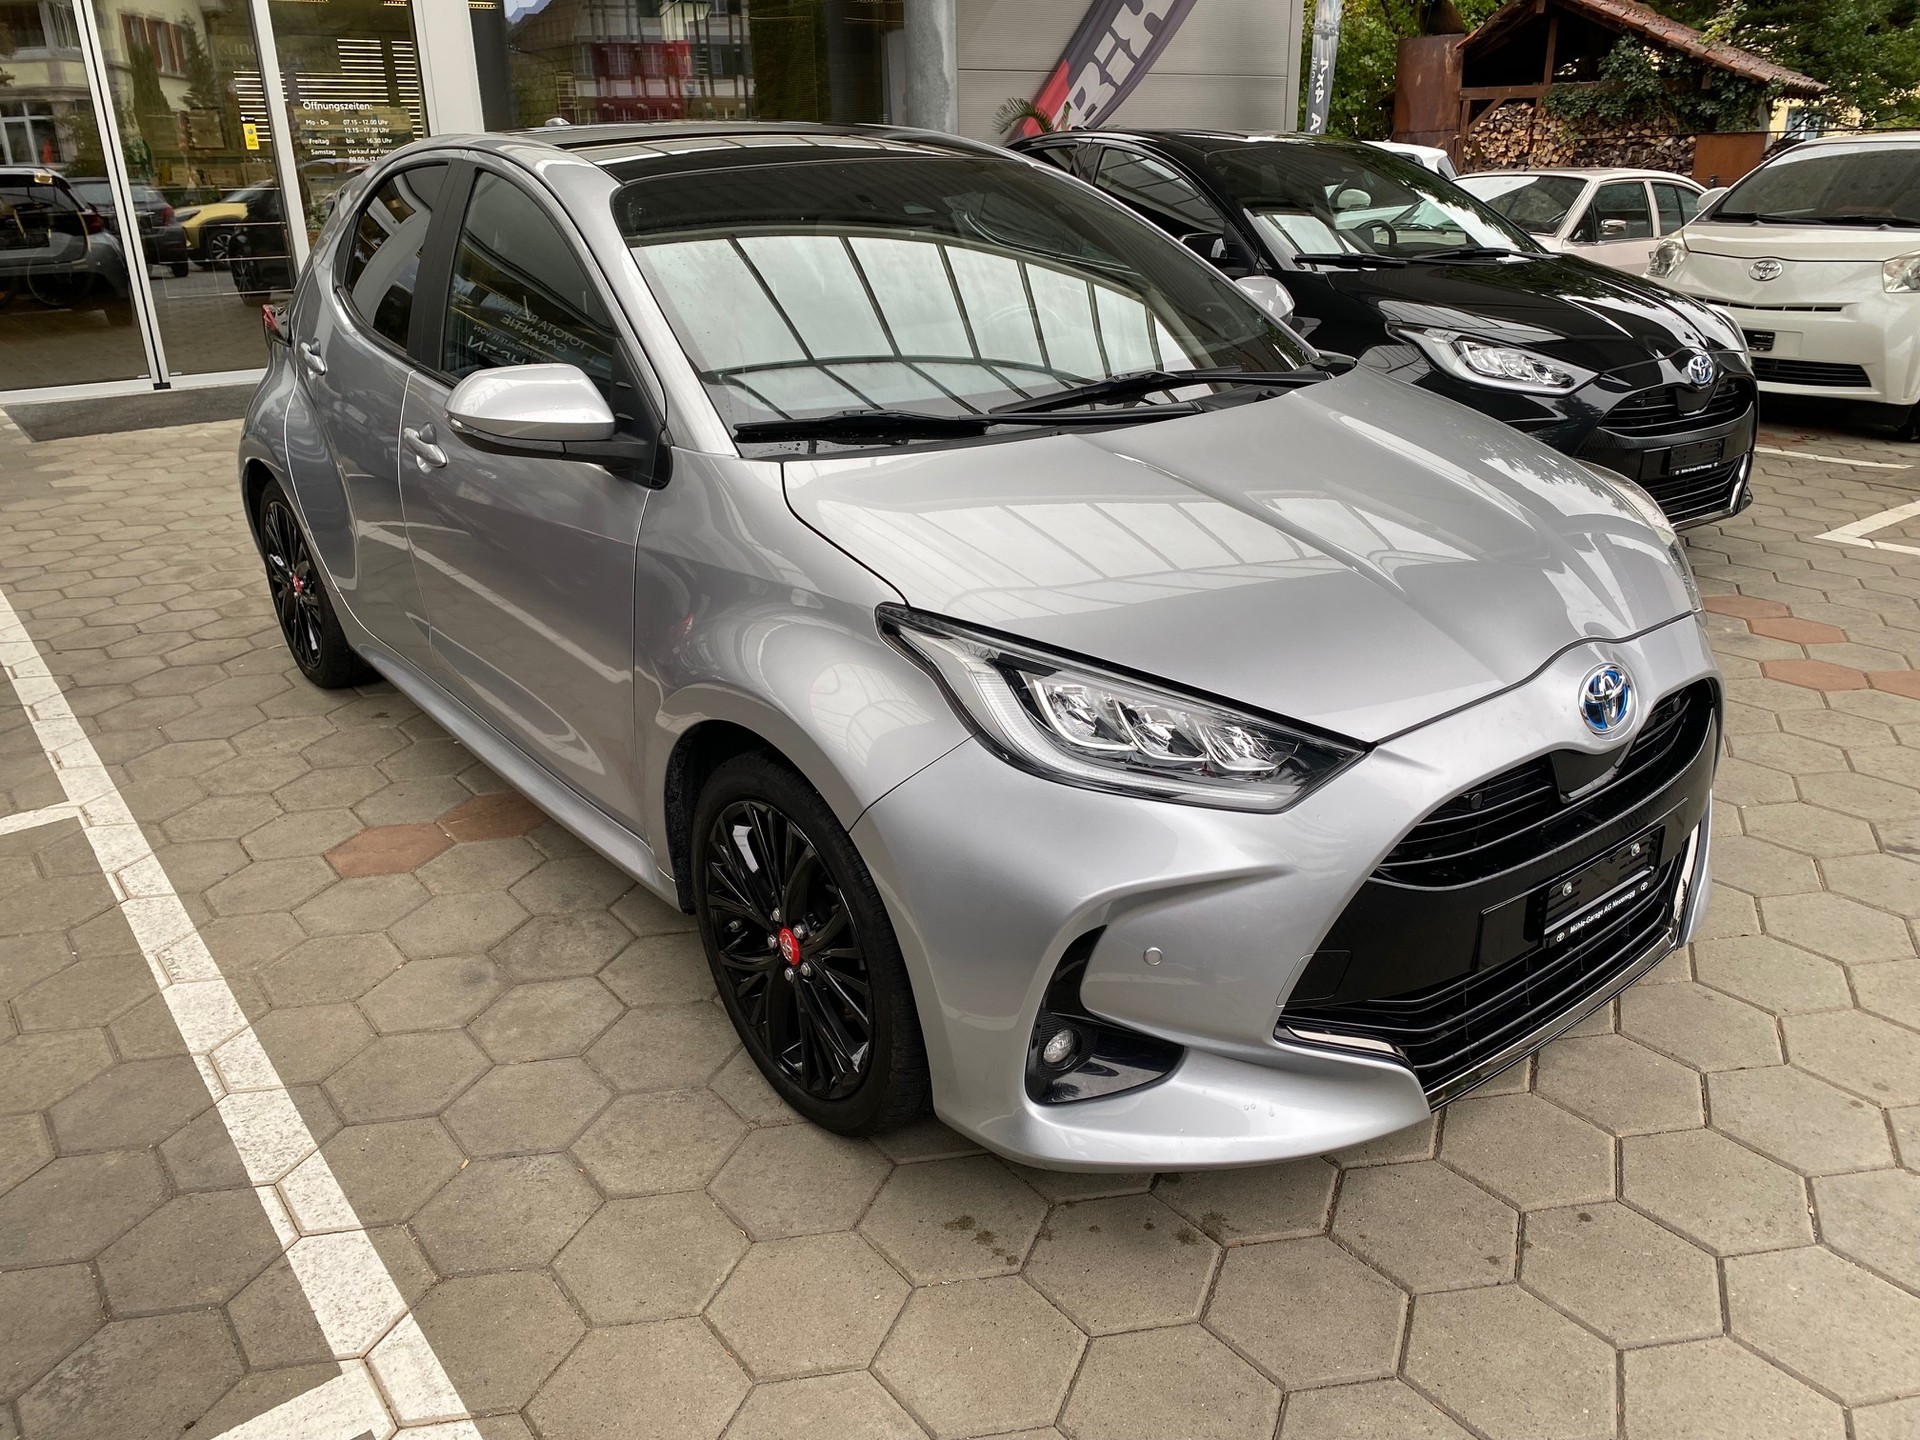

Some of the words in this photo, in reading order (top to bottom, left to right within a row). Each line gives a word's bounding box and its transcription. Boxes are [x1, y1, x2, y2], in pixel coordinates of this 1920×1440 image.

[302, 101, 373, 112] Öffnungszeiten:
[308, 138, 330, 146] Freitag
[310, 148, 337, 156] Samstag
[1604, 903, 1612, 914] AG
